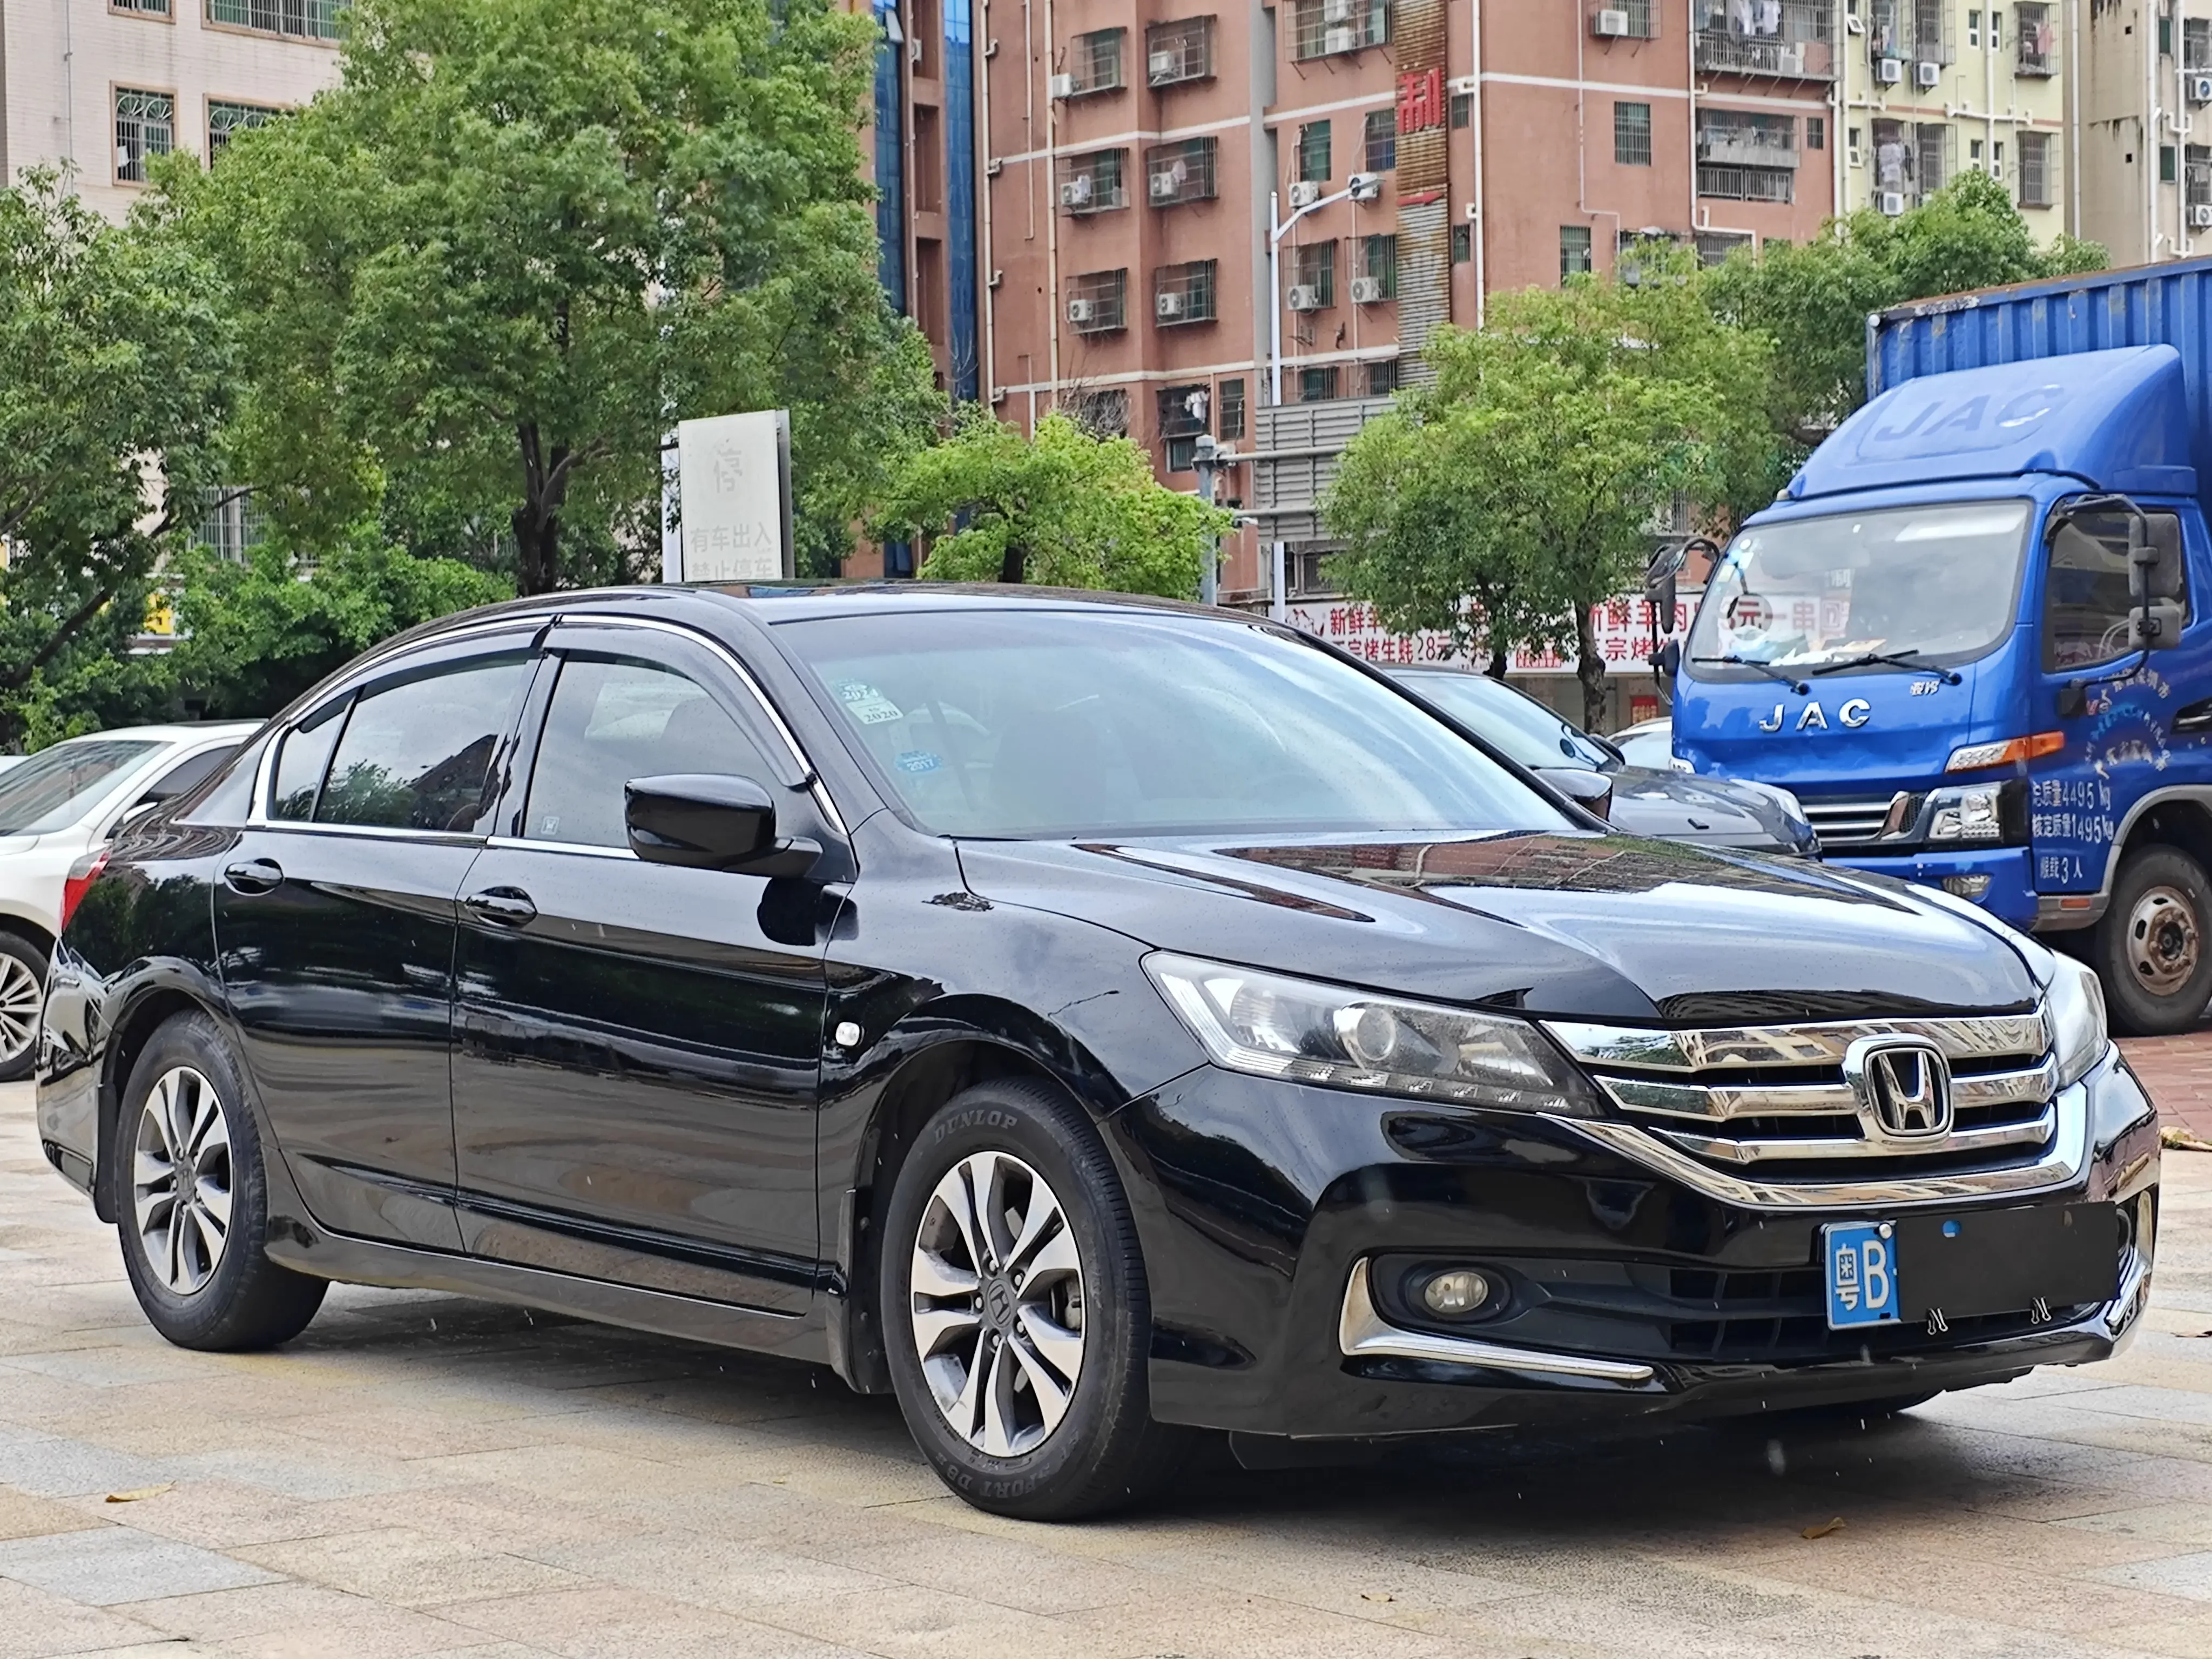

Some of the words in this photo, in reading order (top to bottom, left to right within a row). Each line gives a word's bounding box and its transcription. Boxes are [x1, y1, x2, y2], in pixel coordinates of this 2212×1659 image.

[1873, 383, 2065, 443] JAC
[690, 521, 772, 554] 有车出入
[691, 556, 774, 581] 禁止停车
[1759, 698, 1871, 733] JAC
[935, 1110, 1018, 1145] DUNLOP
[1836, 1239, 1889, 1311] 粤B
